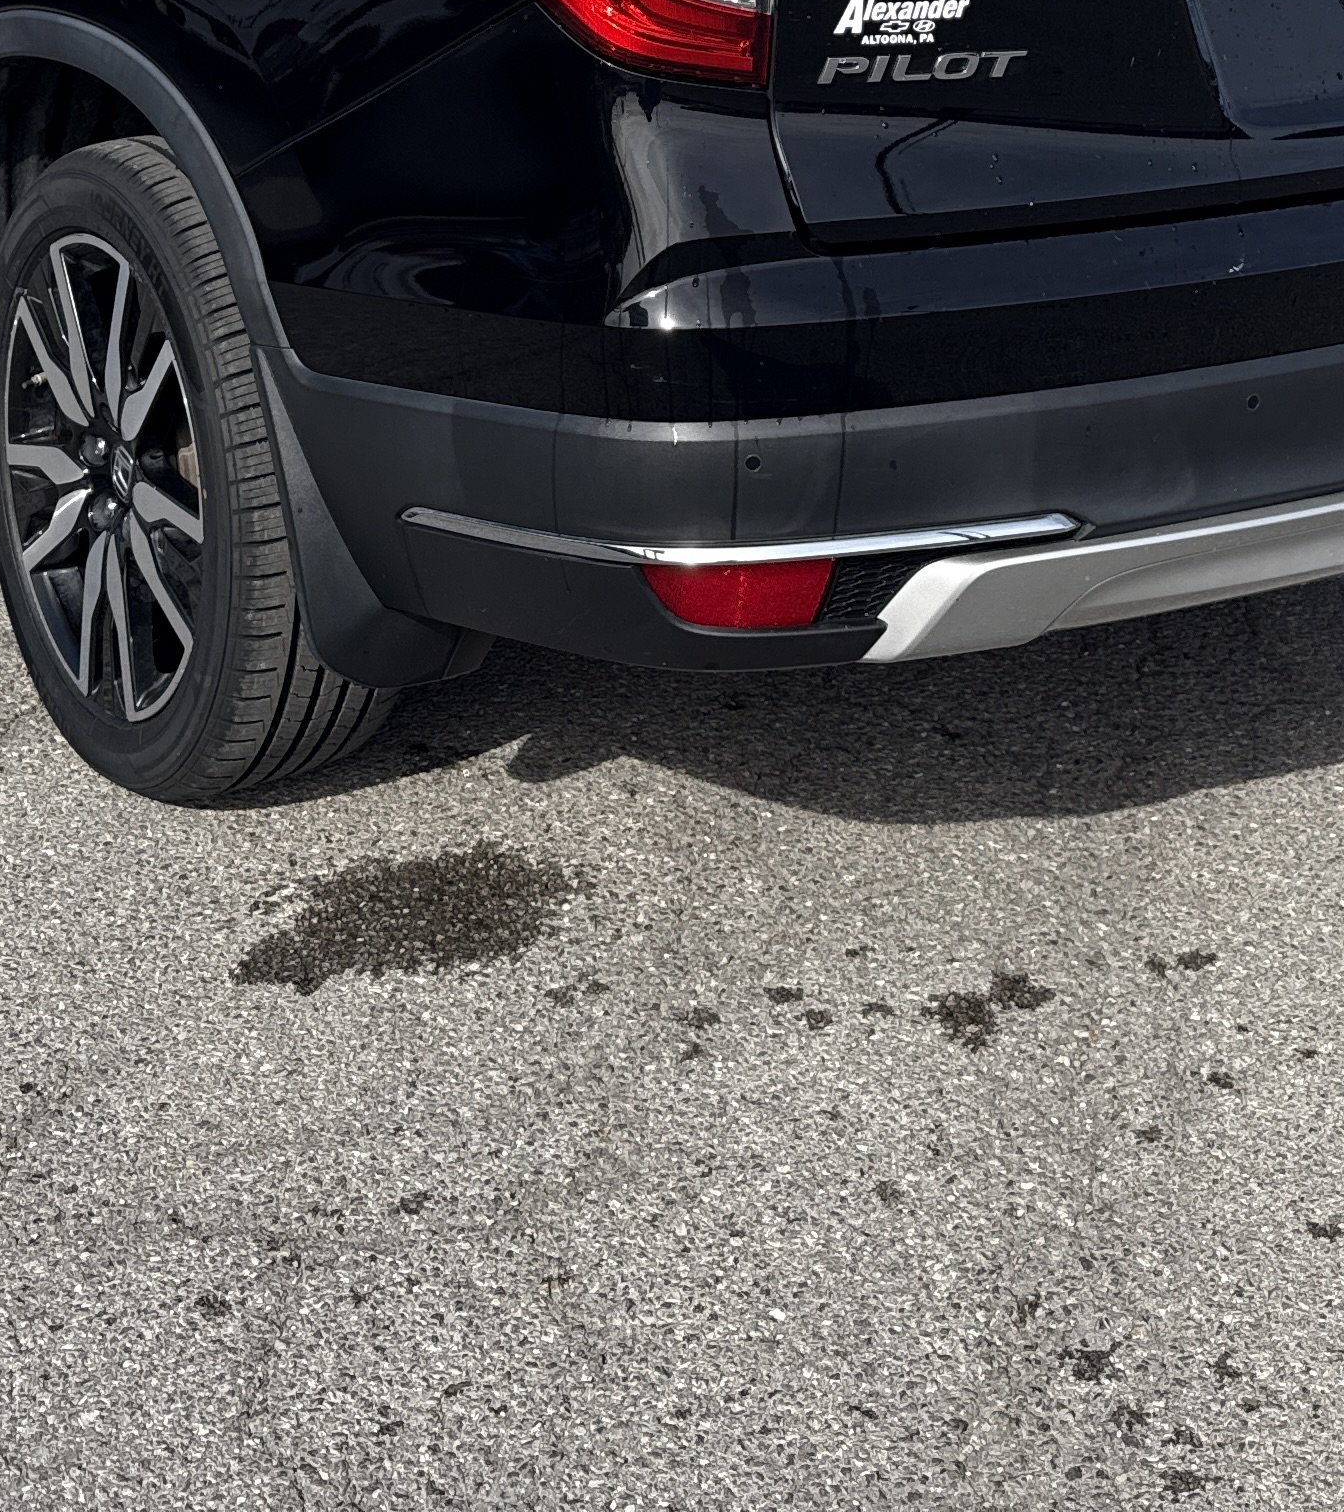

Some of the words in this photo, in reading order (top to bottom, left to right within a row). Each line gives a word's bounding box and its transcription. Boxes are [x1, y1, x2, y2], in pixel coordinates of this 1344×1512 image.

[860, 35, 918, 45] ALTOONA,
[919, 33, 935, 44] PA
[816, 50, 1028, 85] PILOT
